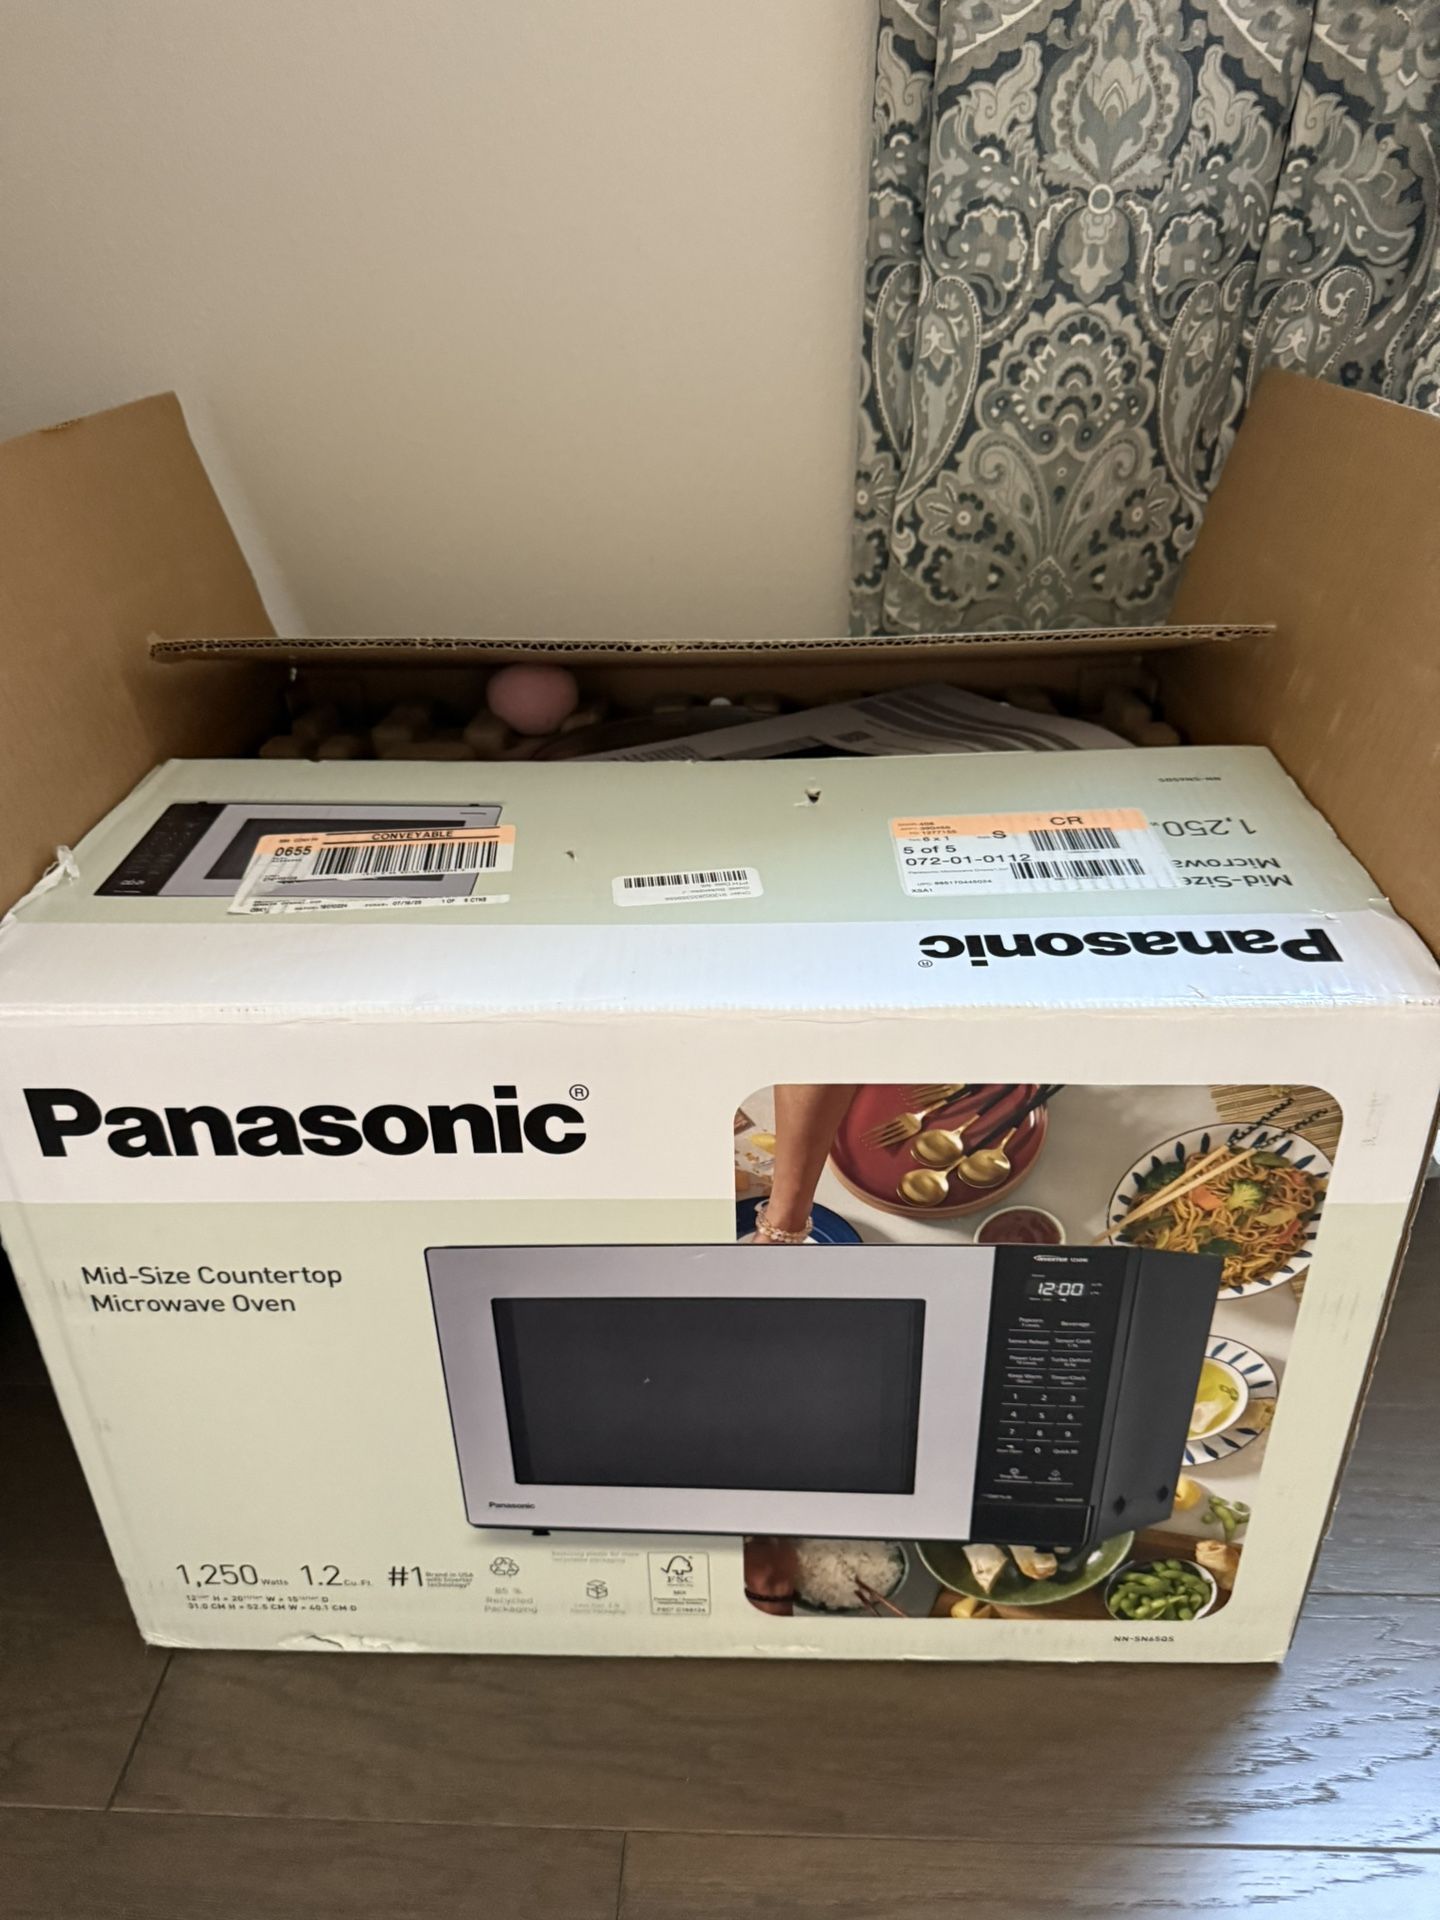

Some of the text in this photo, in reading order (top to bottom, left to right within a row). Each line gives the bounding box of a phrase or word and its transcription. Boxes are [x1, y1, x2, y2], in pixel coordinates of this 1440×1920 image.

[1049, 816, 1084, 826] CR
[1160, 816, 1257, 837] 1,250
[371, 830, 454, 840] CONVEYABLE
[992, 830, 1007, 839] S
[274, 845, 312, 857] 0655
[903, 844, 957, 854] 5 of 5
[905, 853, 1031, 866] 072-01-0112
[1172, 857, 1281, 868] Microwa
[81, 1265, 343, 1288] Mid-Size Countertop
[1038, 1282, 1084, 1296] 12:00
[91, 1294, 296, 1313] Microwave Oven
[176, 1563, 258, 1587] 1,250
[300, 1564, 343, 1586] 1.2
[388, 1566, 423, 1587] #1
